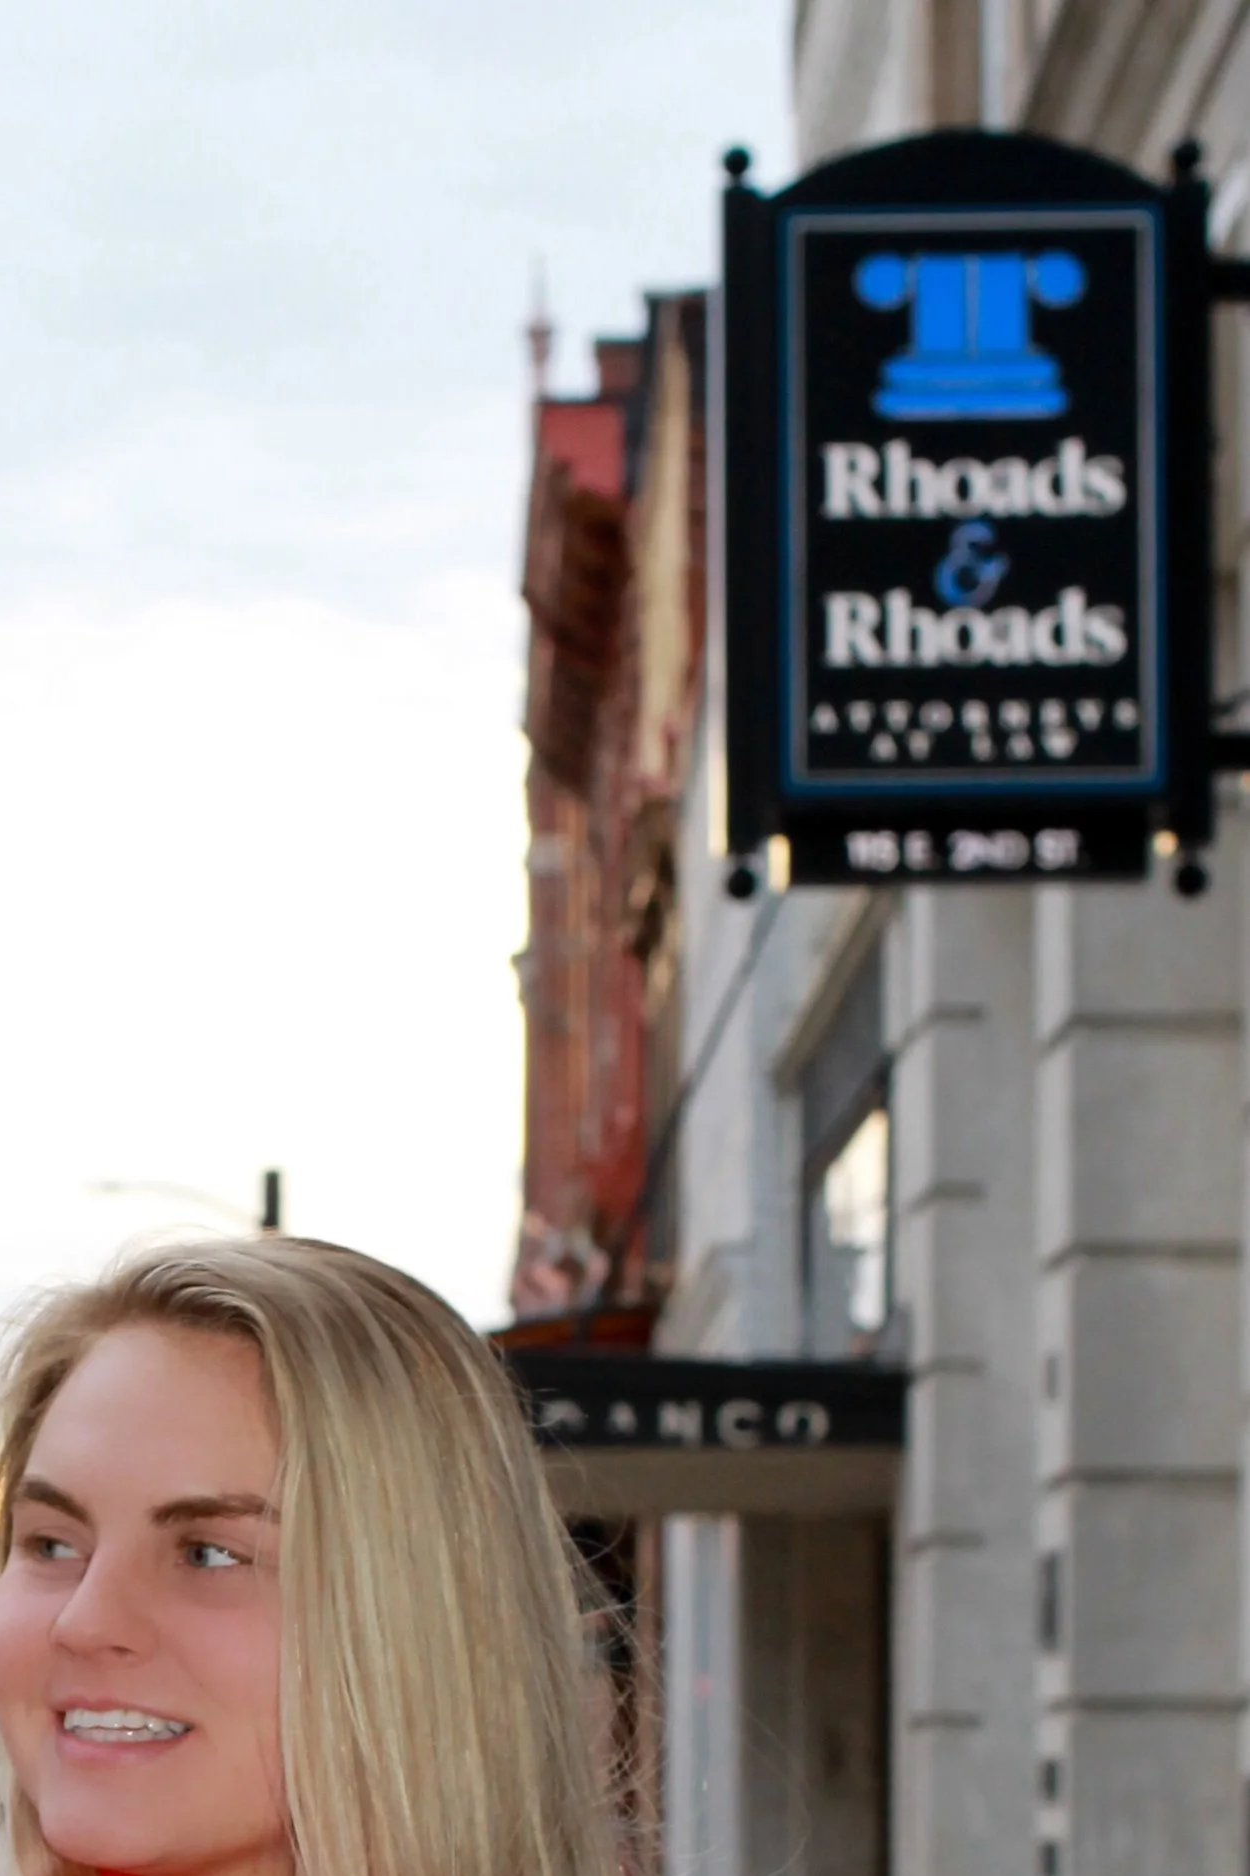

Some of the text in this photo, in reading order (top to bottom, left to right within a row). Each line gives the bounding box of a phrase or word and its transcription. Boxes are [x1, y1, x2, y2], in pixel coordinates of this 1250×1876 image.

[822, 437, 1128, 519] Rhoads
[933, 517, 1012, 608] &
[824, 585, 1129, 668] Rhoads
[810, 699, 1139, 734] ATTORNEYS
[870, 728, 1078, 762] AT LAW
[947, 829, 1031, 872] 2ND
